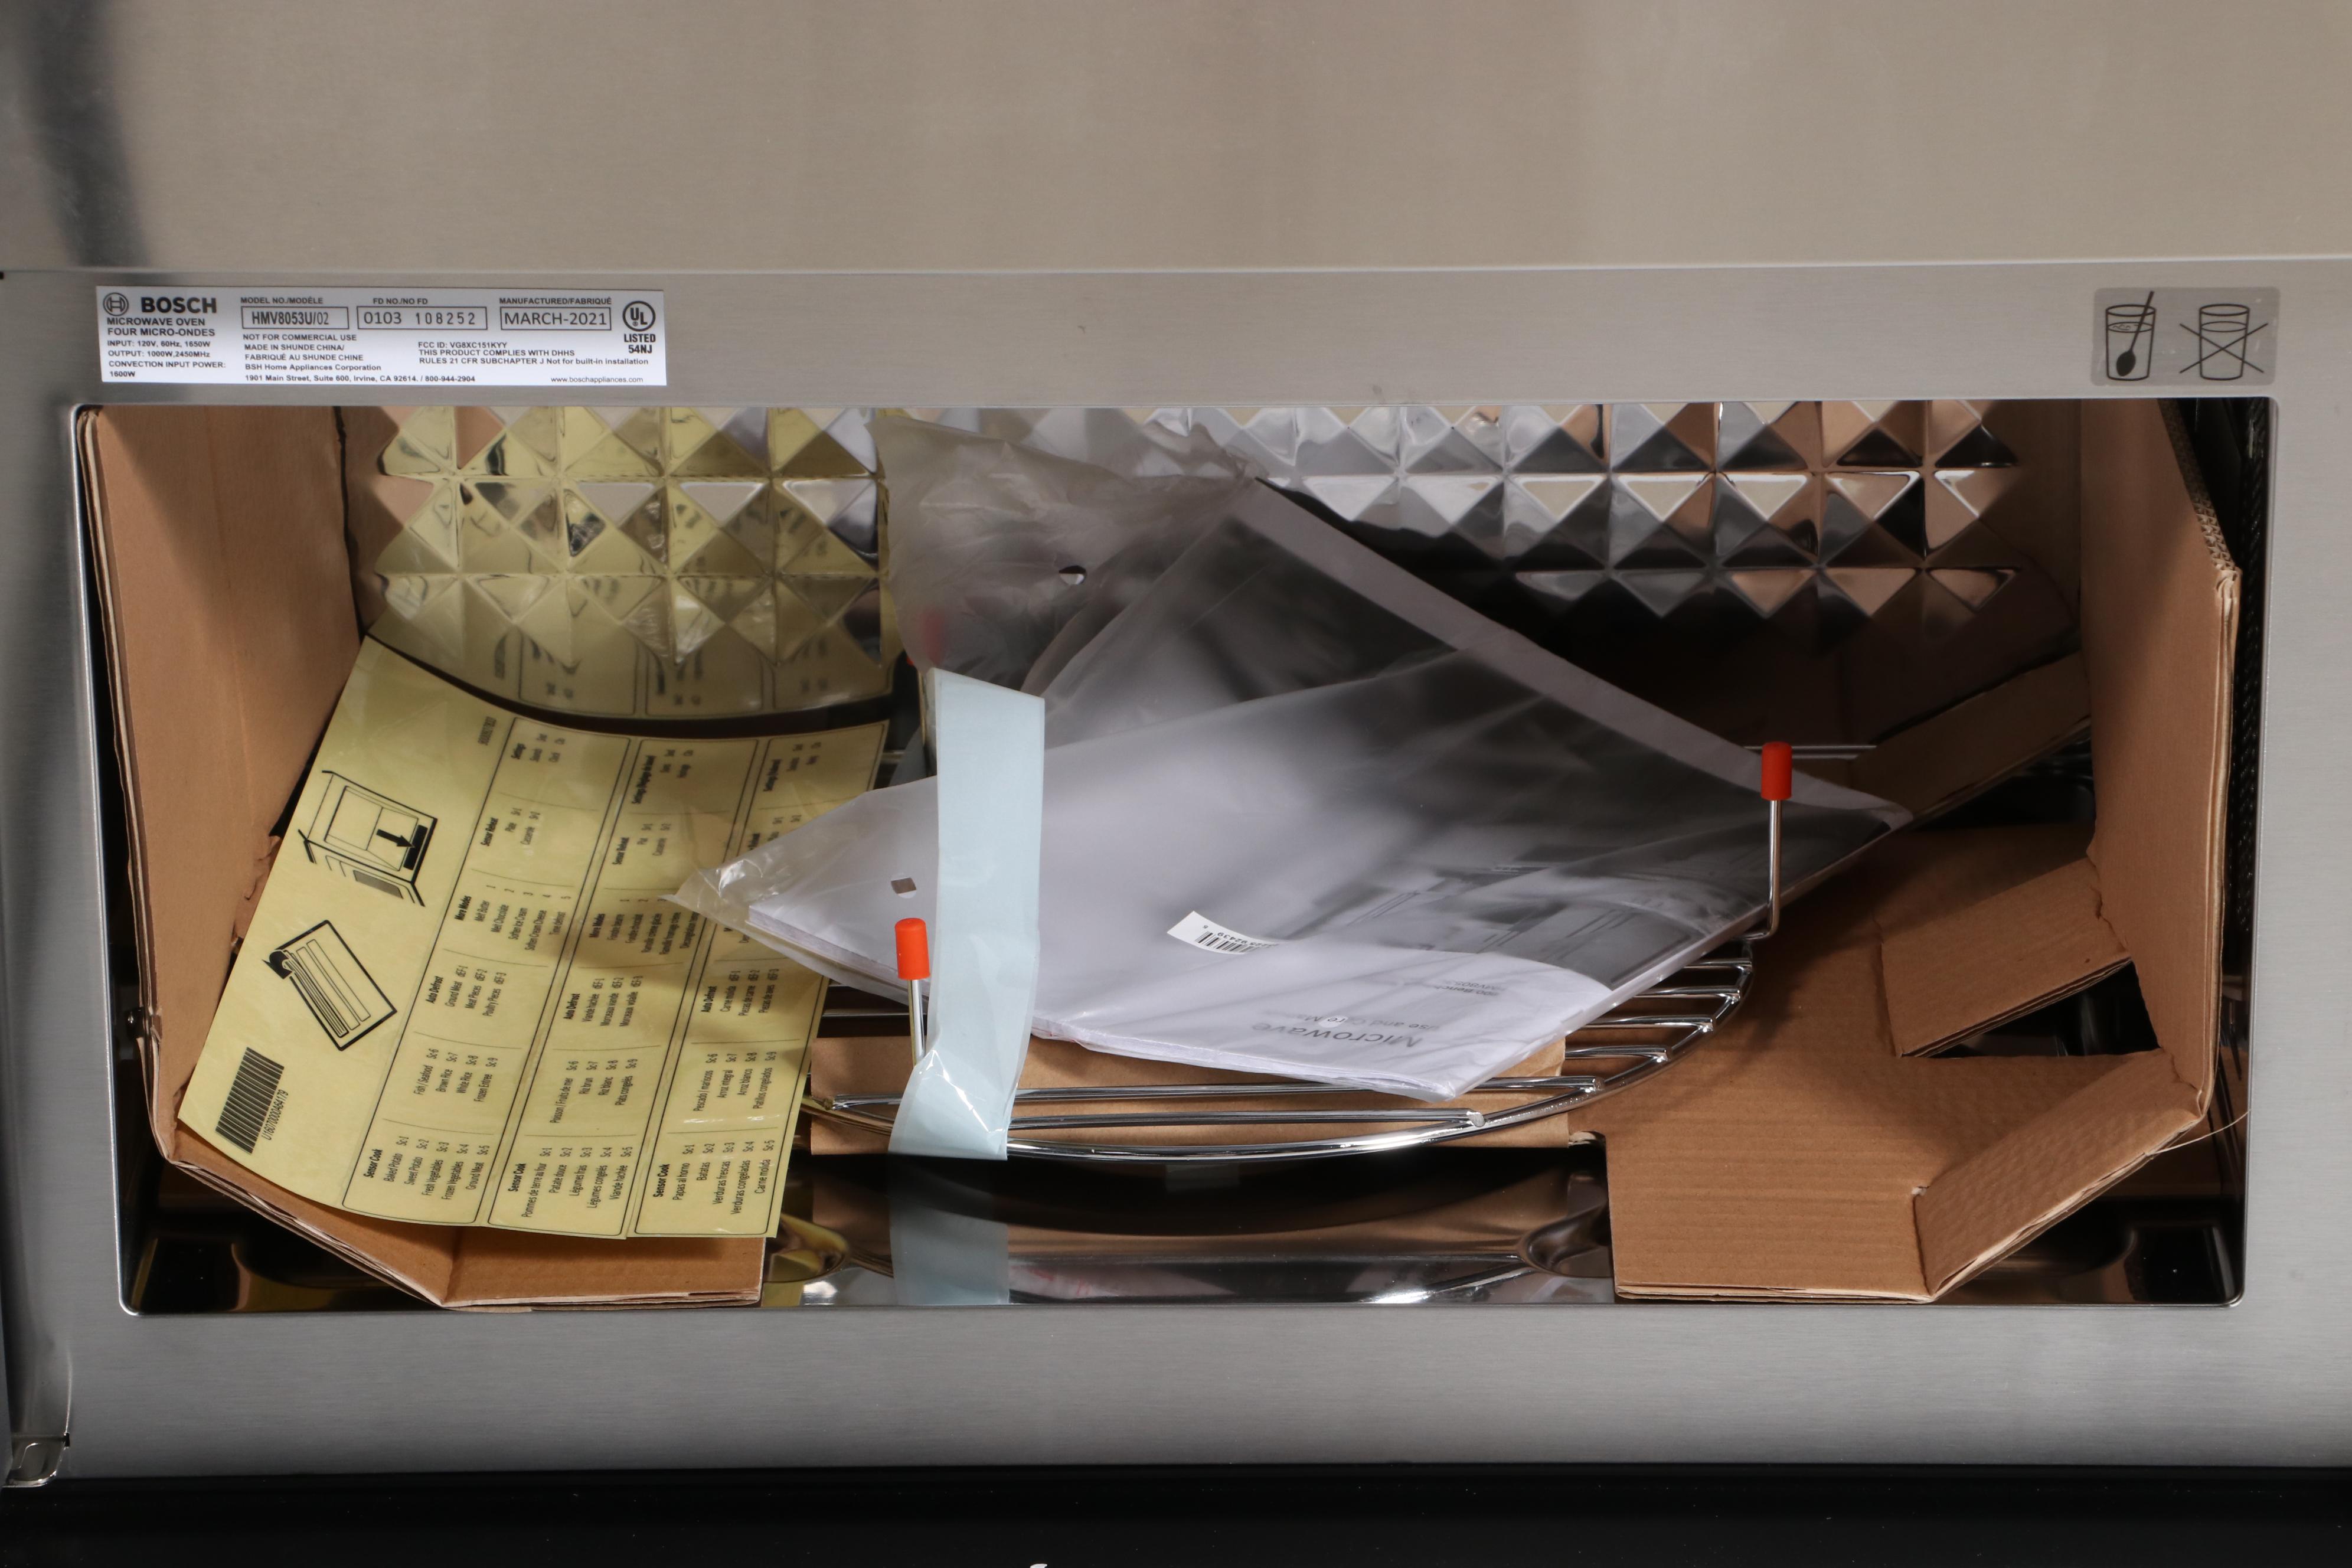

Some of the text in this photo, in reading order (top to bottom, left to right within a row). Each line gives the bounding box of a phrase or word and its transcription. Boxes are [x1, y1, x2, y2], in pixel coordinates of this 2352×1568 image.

[141, 296, 217, 313] BOSCH
[176, 318, 205, 326] OVEN
[251, 311, 329, 325] HMV8053U/02
[364, 312, 476, 325] 0103 108252
[504, 311, 606, 326] MARCH-2021
[630, 307, 648, 325] UL
[140, 328, 215, 337] MICRO-ONDES
[624, 334, 656, 343] LISTED
[246, 353, 286, 361] FABRIQUÉ
[628, 344, 652, 354] 54NJ
[289, 364, 332, 372] Appliances
[1217, 932, 1247, 945] 92439
[426, 976, 443, 1004] Auto Defrost
[450, 981, 462, 991] Meat
[445, 991, 459, 1007] Ground
[1252, 1022, 1423, 1048] Microwave
[426, 1048, 439, 1059] Sc-6
[418, 1065, 433, 1083] Seafood
[436, 1052, 458, 1092] Brown Rice Sc-7
[460, 1072, 472, 1082] Rice
[474, 1057, 498, 1102] Frozen Entree Sc-9
[414, 1086, 426, 1095] Fish
[456, 1082, 469, 1093] White
[262, 1089, 288, 1140] U16070000A64179
[540, 1148, 552, 1157] Sc-1
[682, 1145, 695, 1154] Sc-1
[363, 1149, 383, 1178] Sensor Cook
[384, 1136, 409, 1182] Baked Potato Sc-1
[404, 1139, 429, 1185] Sweet Potato Sc-2
[466, 1145, 489, 1190] Ground Meat Sc-5
[534, 1163, 547, 1171] four
[697, 1144, 715, 1181] Batatas Sc-2
[754, 1141, 775, 1193] Carne molida Sc-5
[422, 1142, 449, 1196] Fresh Vegetables Sc-3
[442, 1144, 469, 1200] Frozen Vegetables Sc-4
[508, 1163, 526, 1191] Sensor Cook
[549, 1148, 572, 1193] Patate douce Sc-2
[569, 1148, 592, 1196] Légumes frais Sc-3
[587, 1147, 612, 1208] Légumes congelés Sc-4
[609, 1146, 632, 1200] Viande hachée Sc-5
[677, 1163, 690, 1177] horno
[712, 1142, 735, 1204] Verduras frescas Sc-3
[731, 1141, 754, 1214] Verduras congeladas Sc-4
[530, 1177, 542, 1189] terre
[653, 1164, 670, 1197] Sensor Cook
[672, 1184, 686, 1200] Papas
[521, 1197, 537, 1217] Pommes
